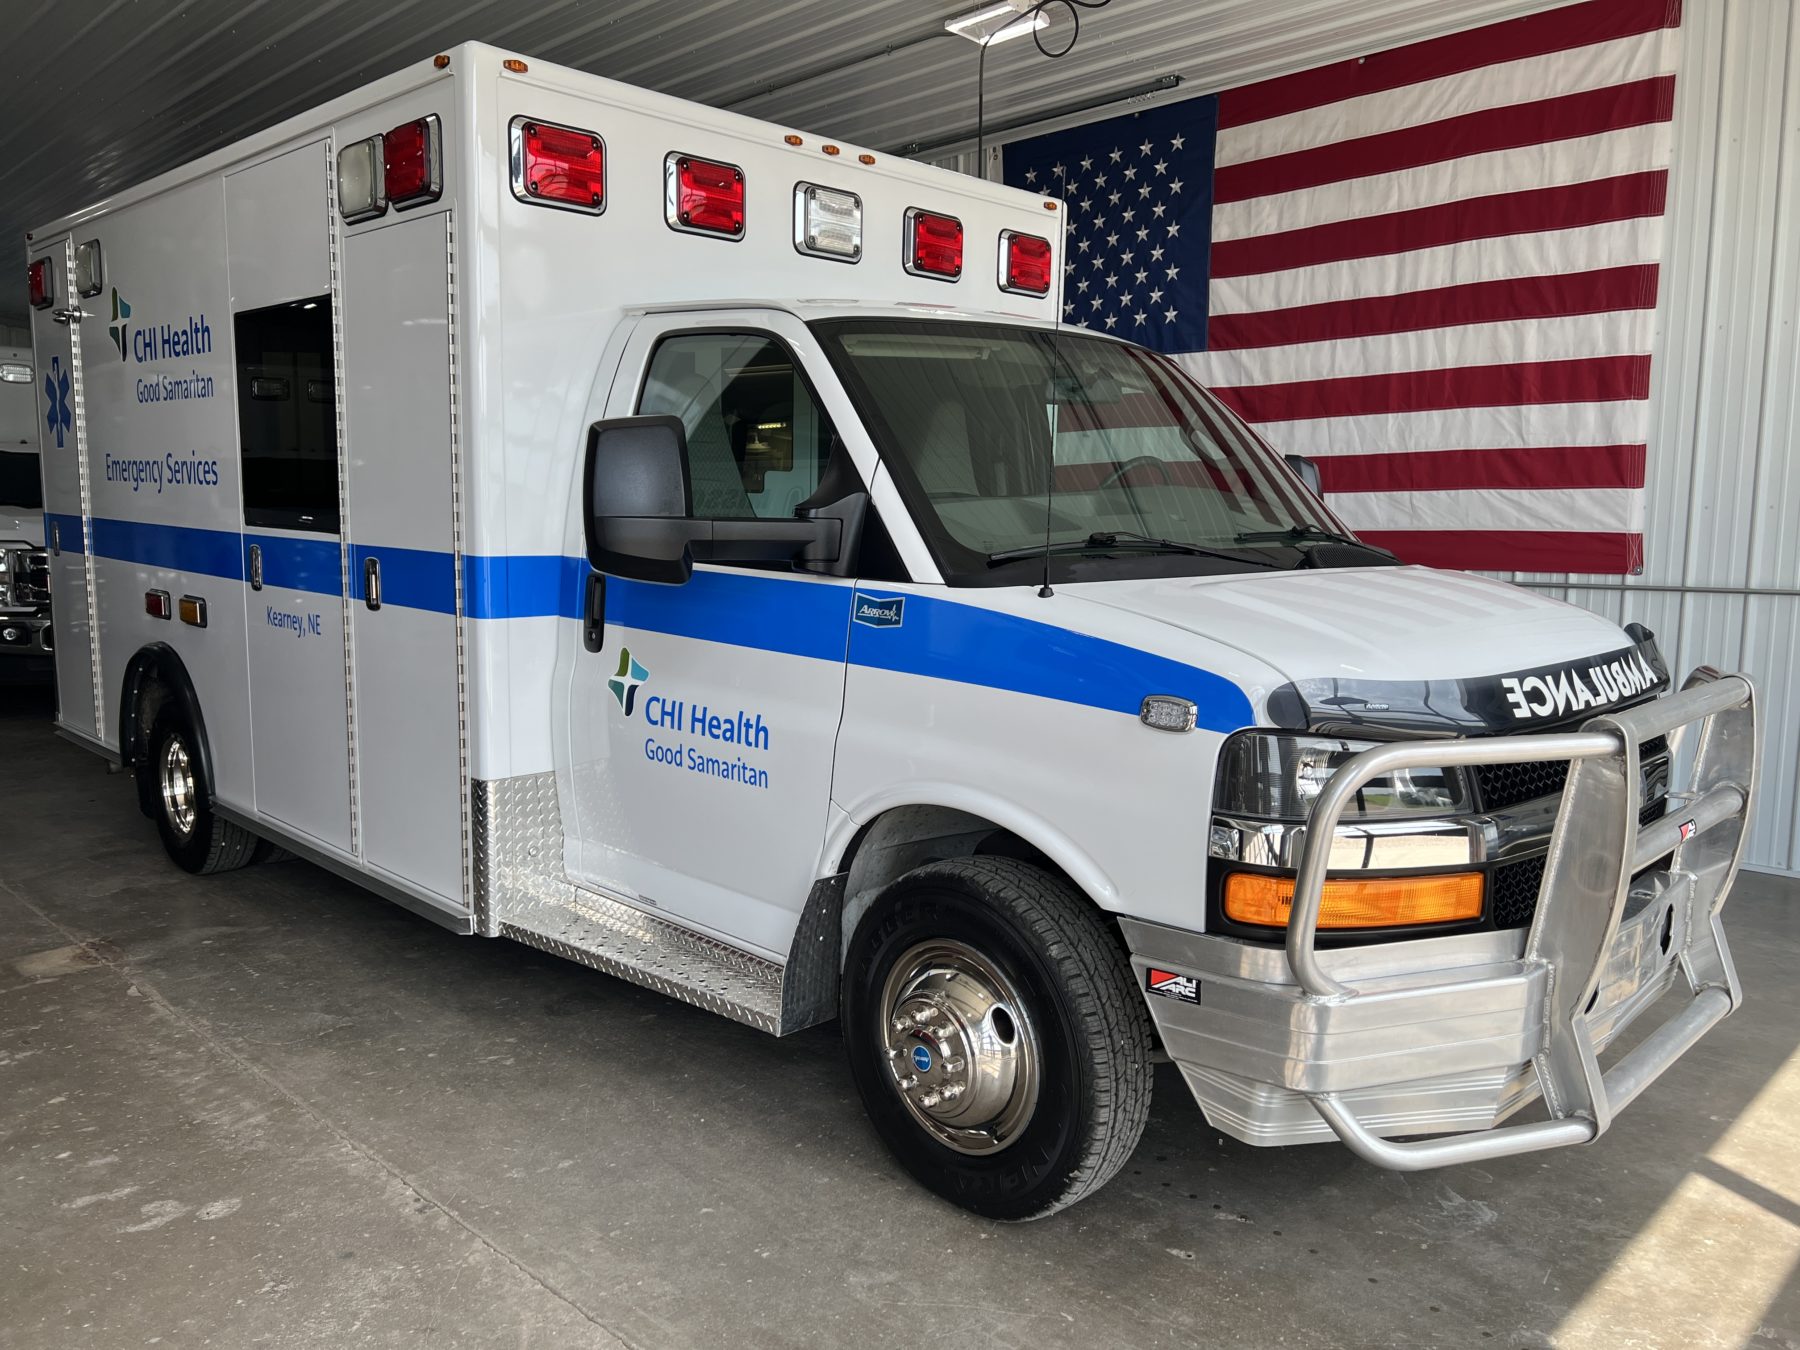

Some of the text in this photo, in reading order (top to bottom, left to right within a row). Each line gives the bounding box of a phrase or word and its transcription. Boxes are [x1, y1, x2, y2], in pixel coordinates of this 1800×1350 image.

[134, 314, 211, 363] CHI Health
[137, 369, 214, 403] Good Samaritan
[105, 449, 218, 494] Emergency Services
[266, 605, 321, 638] Kearney, NE
[645, 696, 769, 750] CHI Health
[645, 738, 768, 789] Good Samaritan
